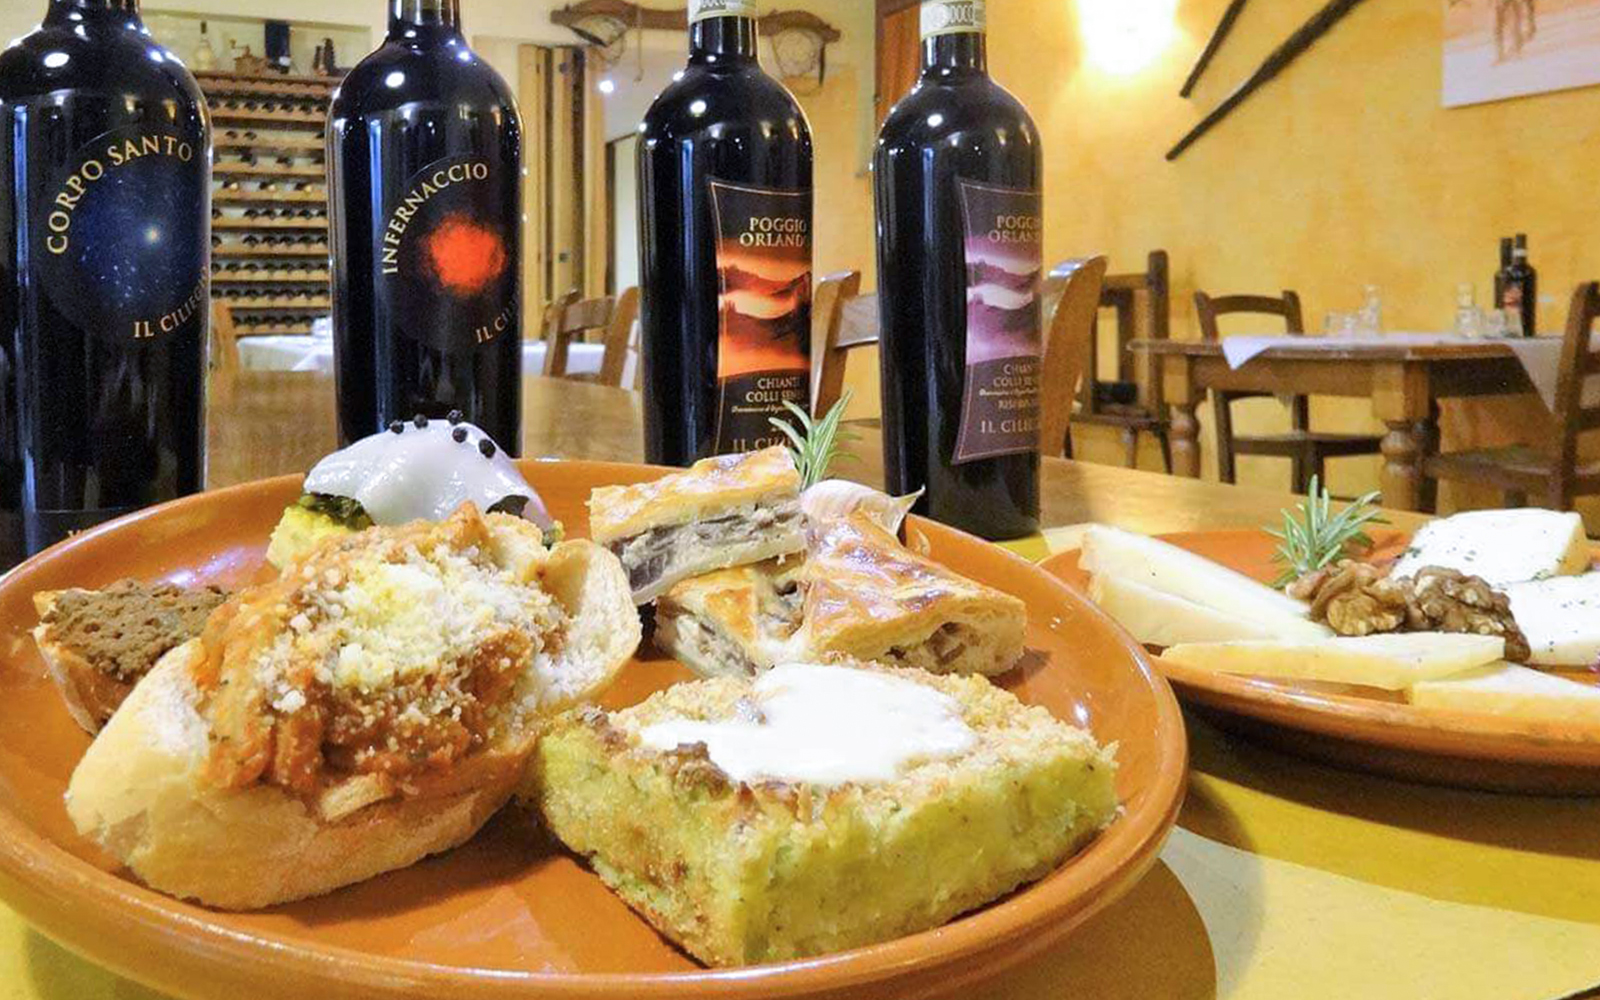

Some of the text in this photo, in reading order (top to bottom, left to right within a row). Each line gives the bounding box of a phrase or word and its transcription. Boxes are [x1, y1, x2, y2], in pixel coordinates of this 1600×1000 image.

[47, 135, 192, 254] CORPO SANTO
[381, 163, 488, 274] INFERNACCIO
[134, 321, 155, 338] IL
[475, 326, 493, 343] IL
[745, 391, 779, 402] COLLI
[980, 420, 997, 434] IL
